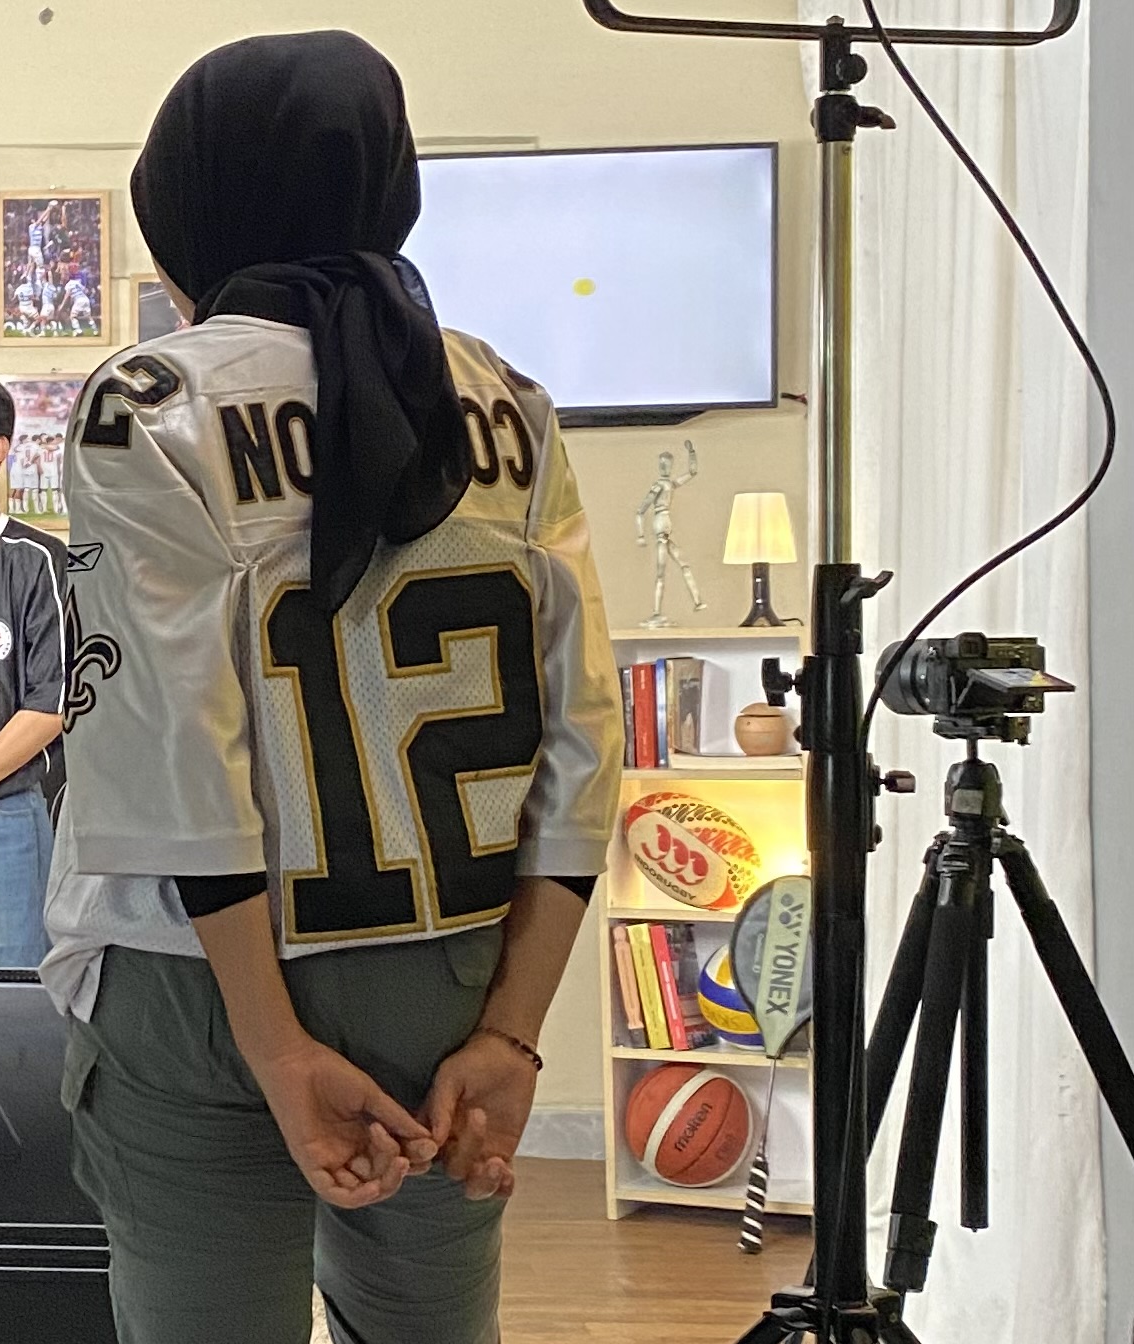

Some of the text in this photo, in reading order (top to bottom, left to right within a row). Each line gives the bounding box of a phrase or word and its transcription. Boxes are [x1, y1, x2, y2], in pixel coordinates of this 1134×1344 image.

[259, 561, 545, 945] 12
[765, 942, 799, 1016] YONEX
[674, 1102, 713, 1153] molten
